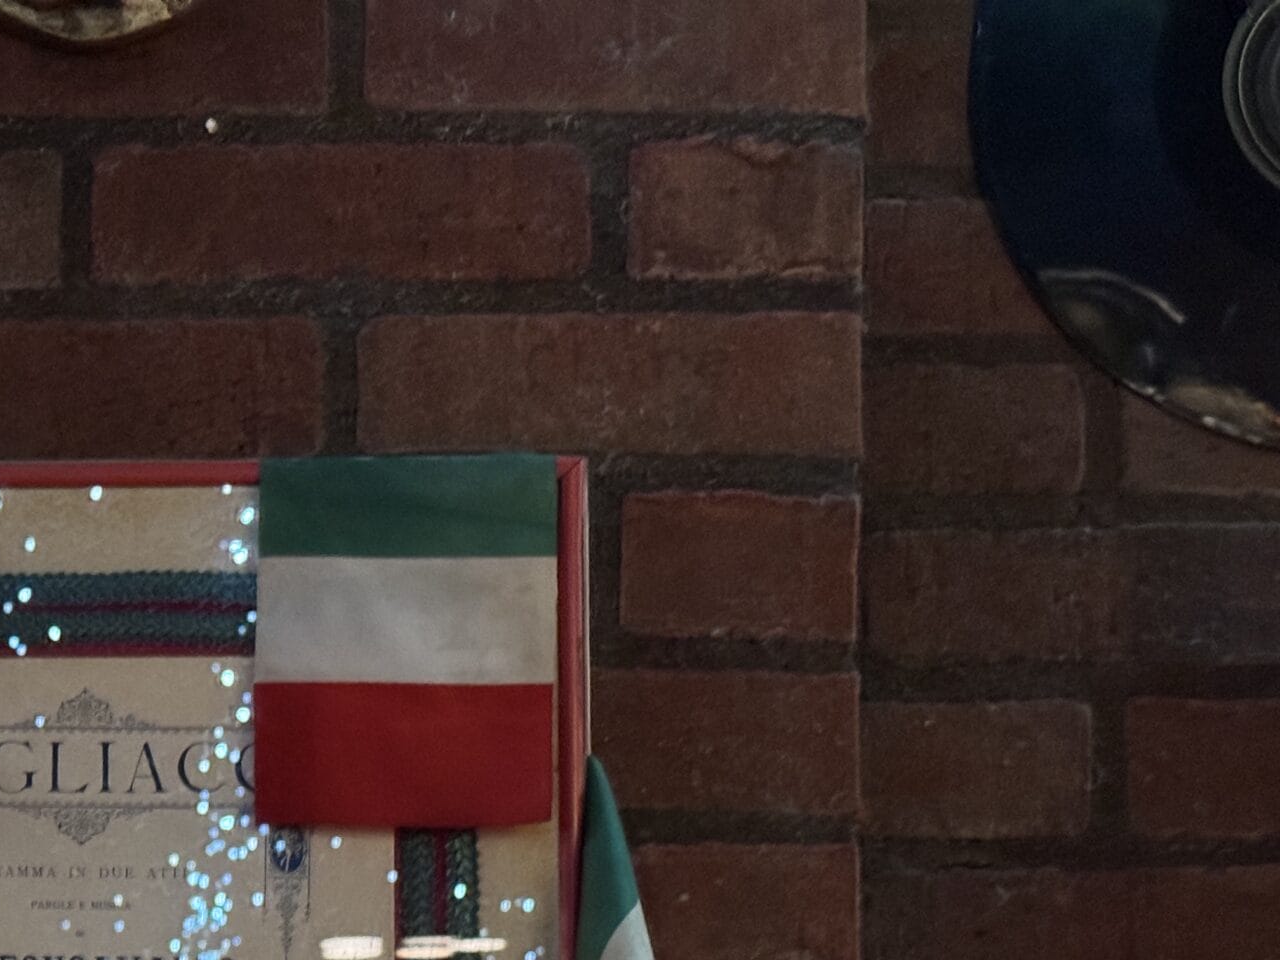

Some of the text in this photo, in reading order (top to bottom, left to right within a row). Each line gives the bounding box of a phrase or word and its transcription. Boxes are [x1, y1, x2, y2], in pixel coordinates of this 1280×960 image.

[68, 865, 87, 879] IN
[99, 865, 135, 880] DUE
[30, 899, 74, 910] PAROLE
